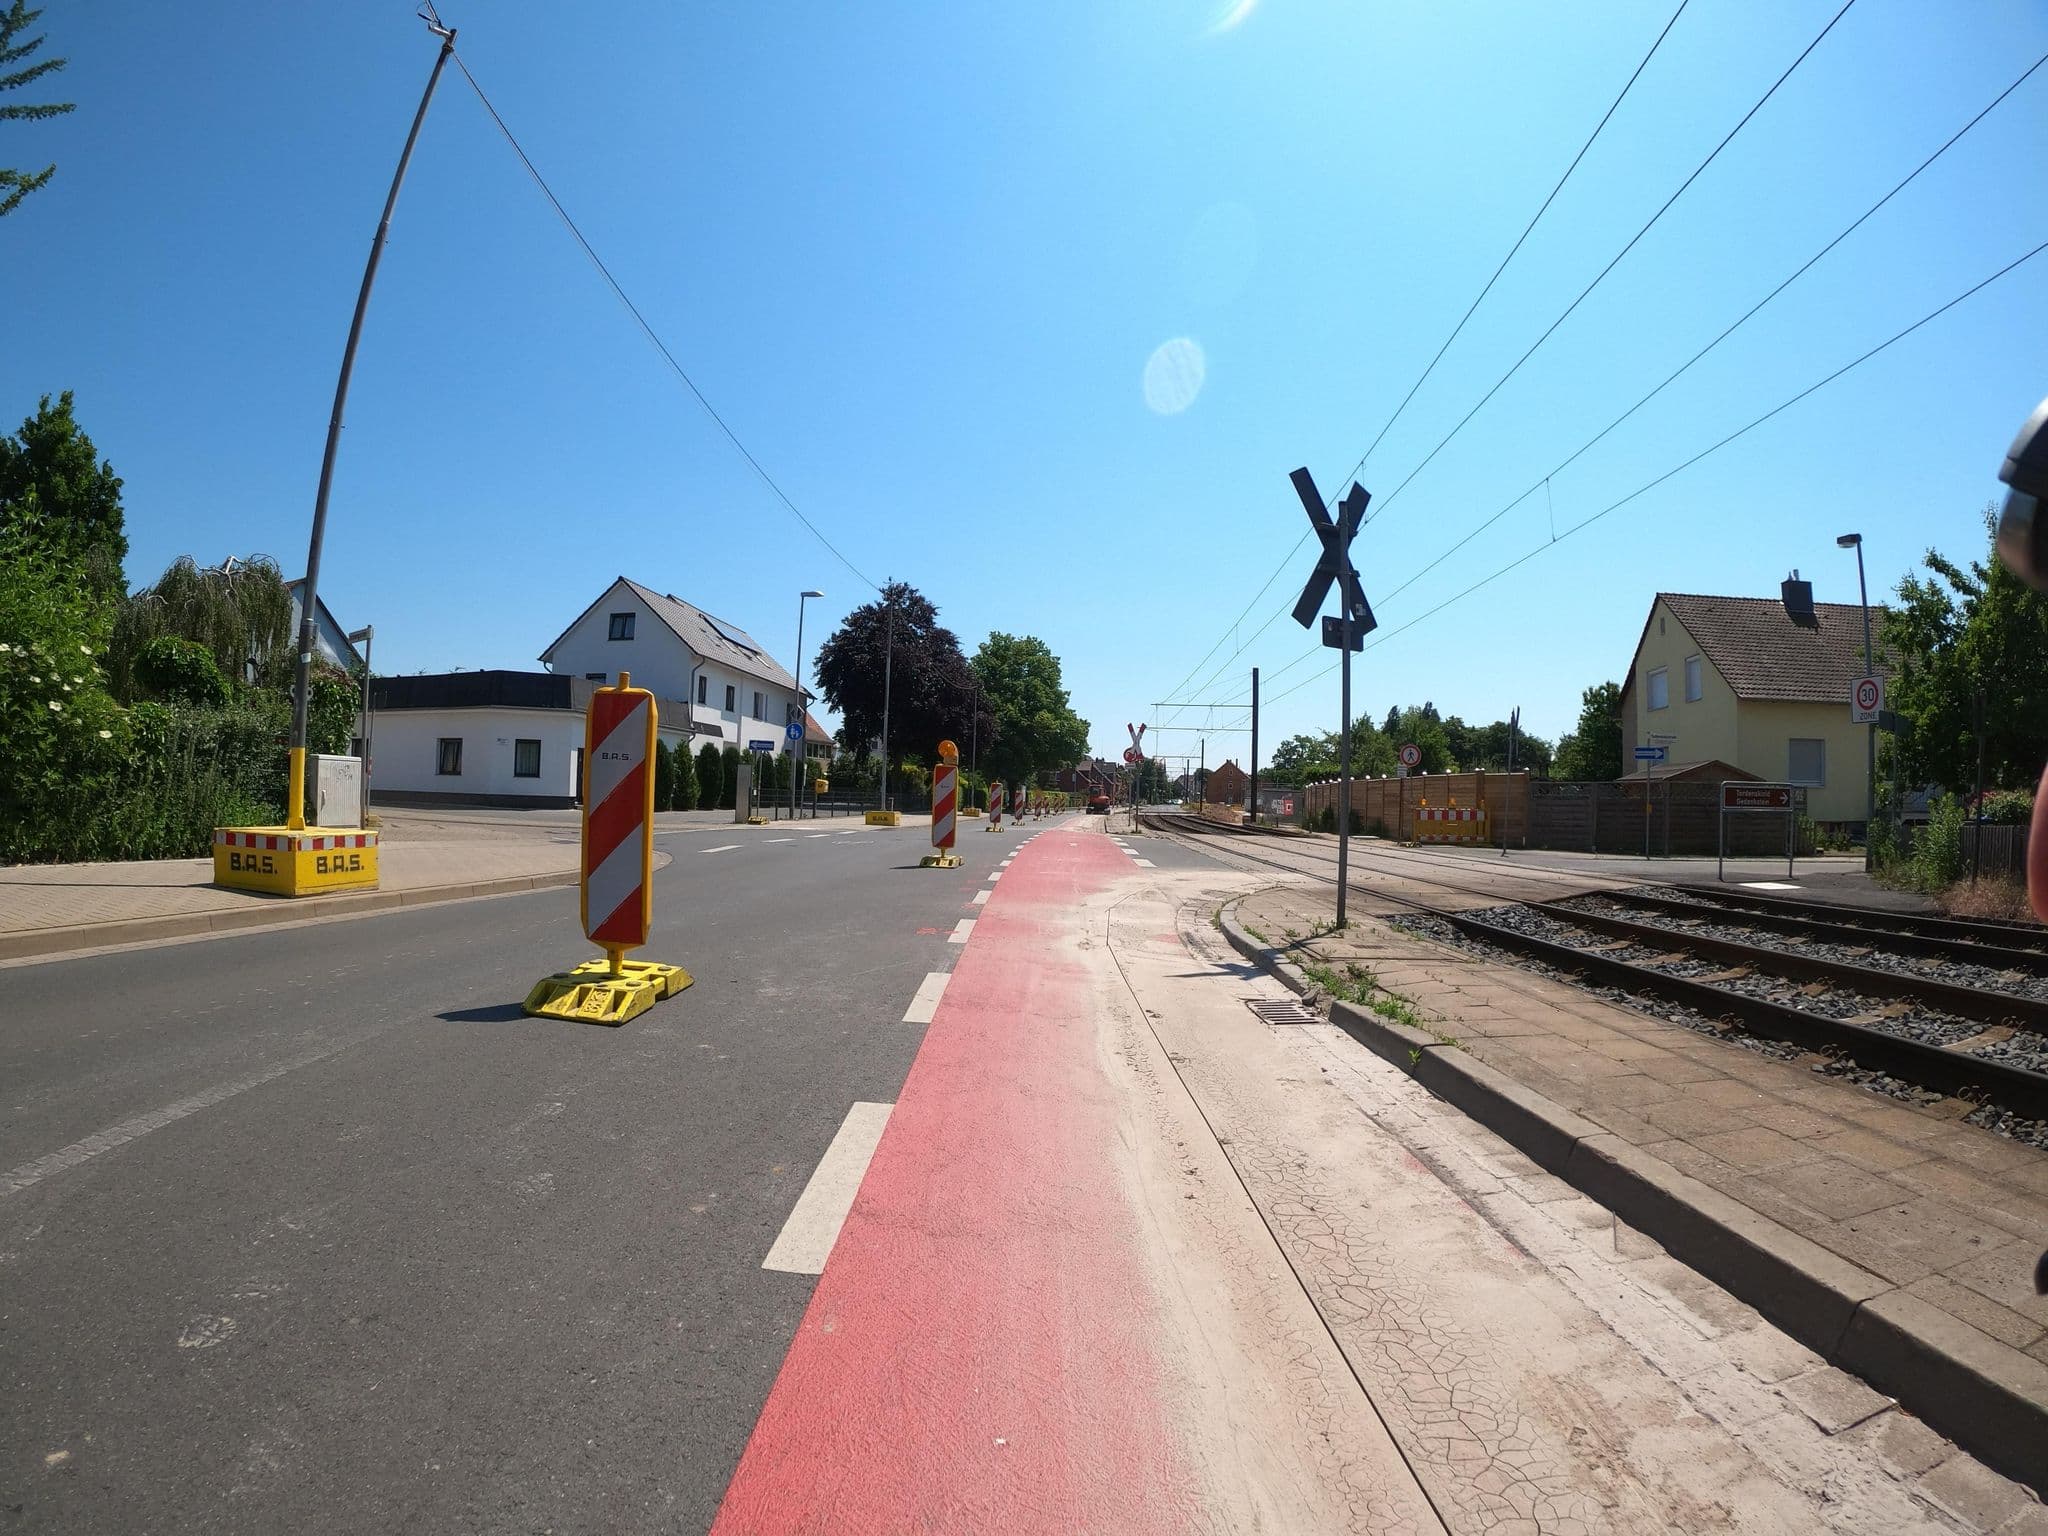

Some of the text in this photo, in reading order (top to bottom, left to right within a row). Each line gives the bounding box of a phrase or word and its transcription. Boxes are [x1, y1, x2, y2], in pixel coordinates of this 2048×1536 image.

[1862, 688, 1875, 702] 30
[1860, 711, 1877, 720] ZONE
[602, 752, 632, 761] B.A.S.
[230, 852, 278, 875] B.A.S.
[316, 854, 365, 874] B.A.S.
